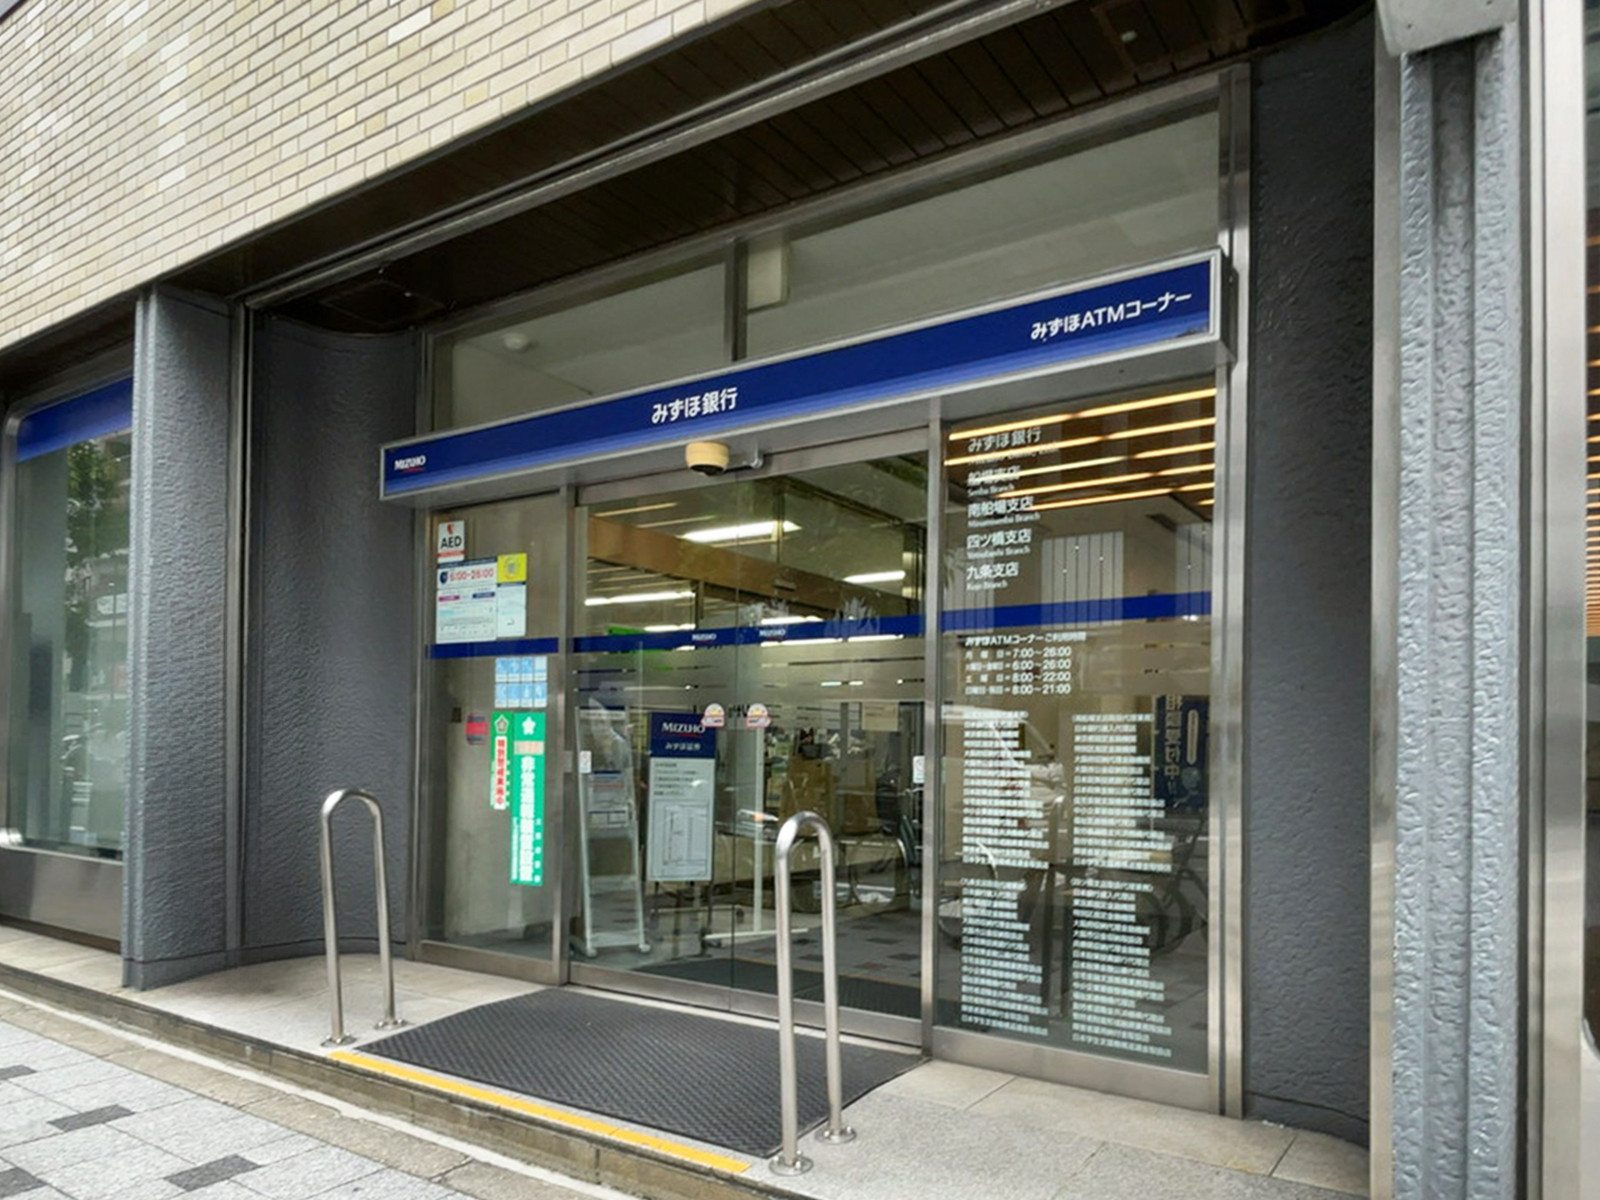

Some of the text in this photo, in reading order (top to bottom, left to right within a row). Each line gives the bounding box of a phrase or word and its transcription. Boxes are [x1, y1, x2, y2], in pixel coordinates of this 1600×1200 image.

[1030, 291, 1193, 341] みずほATMコーナー
[651, 386, 738, 424] みずほ銀行
[968, 426, 1042, 453] みずほ銀行
[394, 454, 427, 471] MIZUHO
[441, 536, 462, 549] AED
[967, 528, 1032, 550] 四ツ橋支店
[966, 562, 1020, 581] 九条支店
[661, 721, 706, 734] MIZUHO
